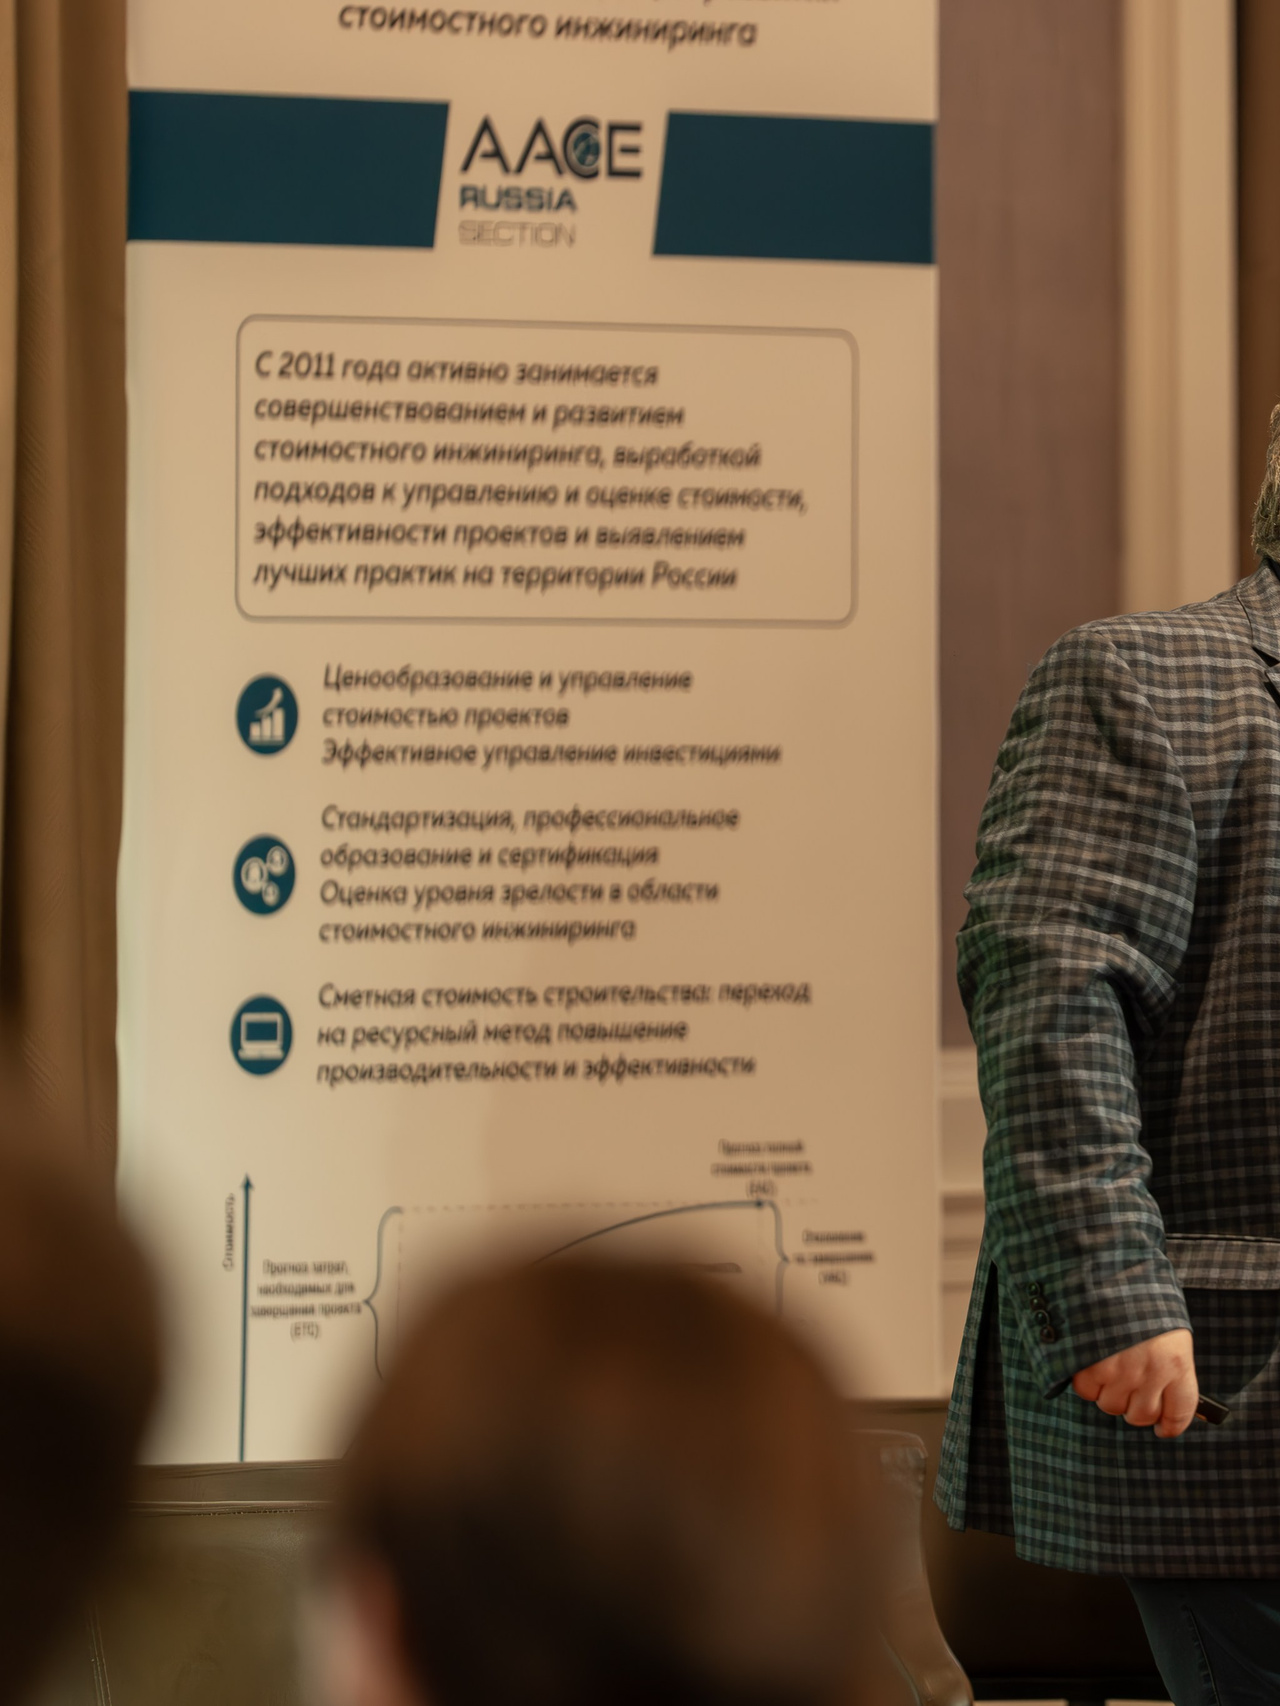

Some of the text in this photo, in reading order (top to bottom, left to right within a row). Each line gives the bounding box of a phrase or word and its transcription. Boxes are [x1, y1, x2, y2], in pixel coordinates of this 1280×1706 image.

[339, 3, 757, 50] стоимостного инжиниринга
[459, 114, 643, 181] AACE
[459, 184, 578, 212] RUSSIA
[459, 219, 576, 247] SECTION
[254, 352, 658, 387] С 2011 года активно занимается
[254, 397, 684, 430] совершенствованием и развитием
[254, 439, 760, 472] стоимостного инжиниринга, выработкой
[254, 481, 807, 514] подходов к управлению и оценке стоимости,
[254, 517, 745, 551] эффективности проектов и выявлением
[253, 561, 737, 593] лучших практик на территории России
[323, 664, 693, 696] Ценообразование и управление
[322, 706, 570, 733] стоимостью проектов
[322, 739, 781, 770] Эффективное управление инвестициями
[322, 802, 740, 835] Стандартизация, профессиональное
[320, 843, 659, 872] образование и сертификация
[320, 879, 719, 909] Оценка уровня зрелости в области
[319, 920, 636, 943] стоимостного инжиниринга
[318, 983, 812, 1011] Сметная стоимость строительства: переход
[318, 1020, 688, 1052] на ресурсный метод повышение
[317, 1054, 755, 1088] производительности и эффективности
